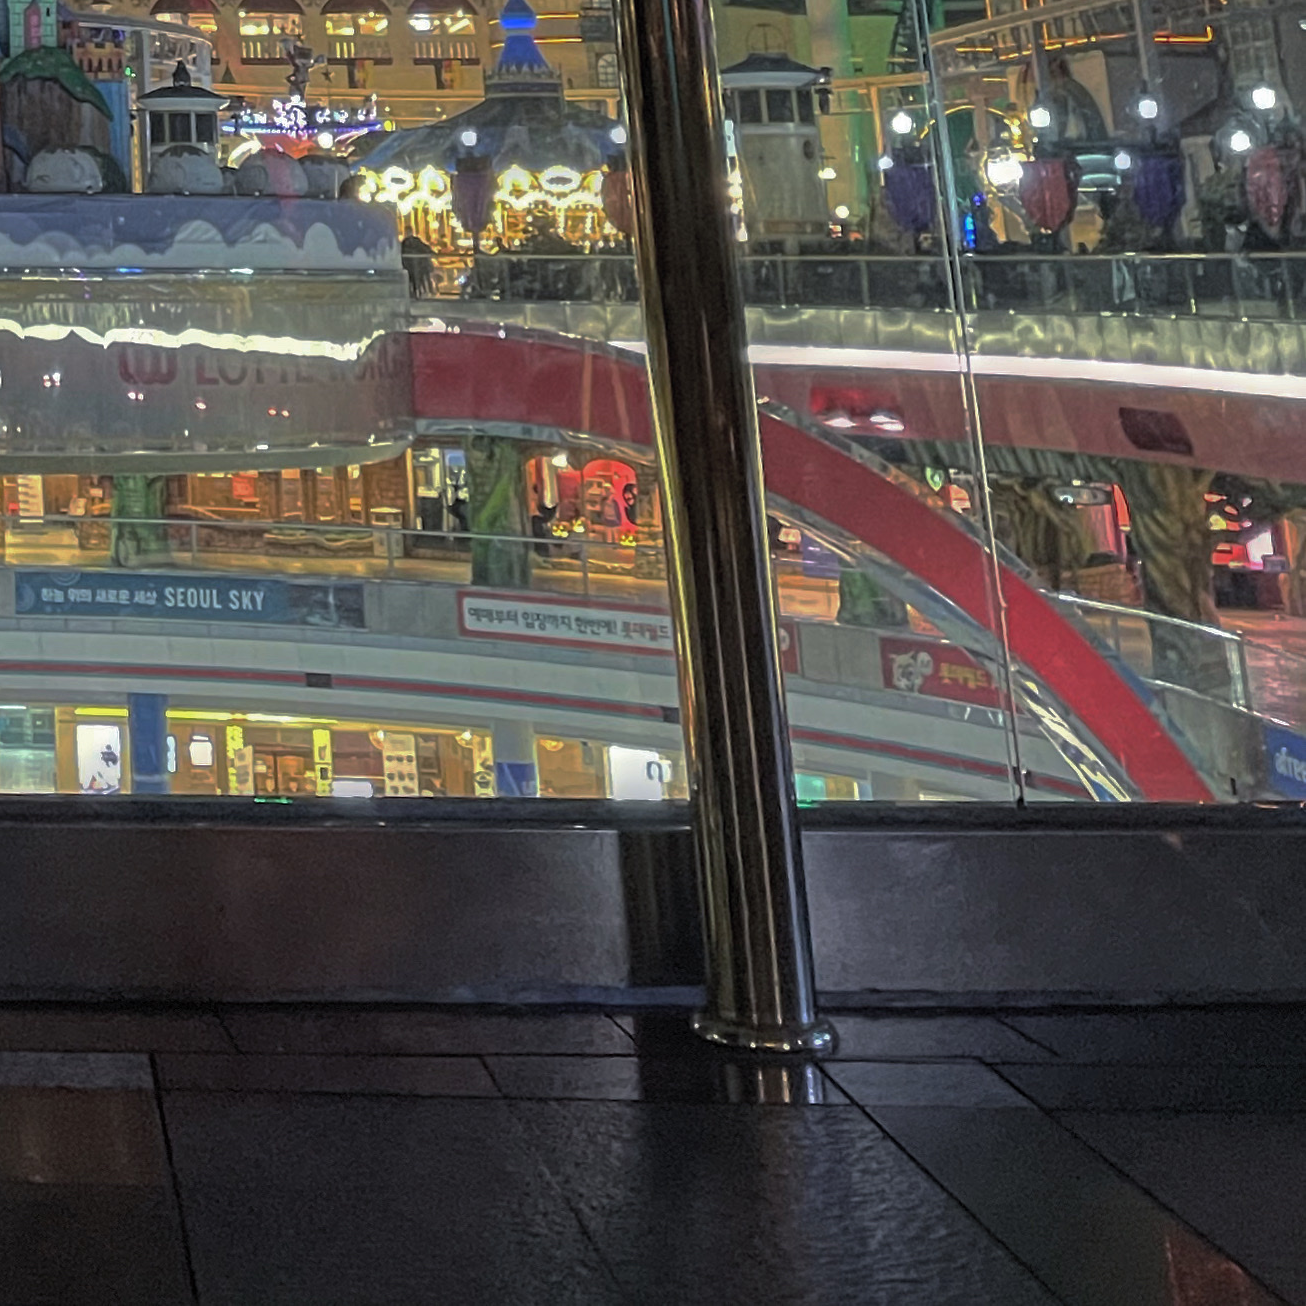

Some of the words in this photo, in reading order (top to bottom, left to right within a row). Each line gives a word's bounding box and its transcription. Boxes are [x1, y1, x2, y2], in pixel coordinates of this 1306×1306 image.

[164, 586, 223, 609] SEOUL
[228, 589, 265, 611] SKY
[467, 607, 519, 626] 예매부터
[522, 610, 573, 631] 입장까지
